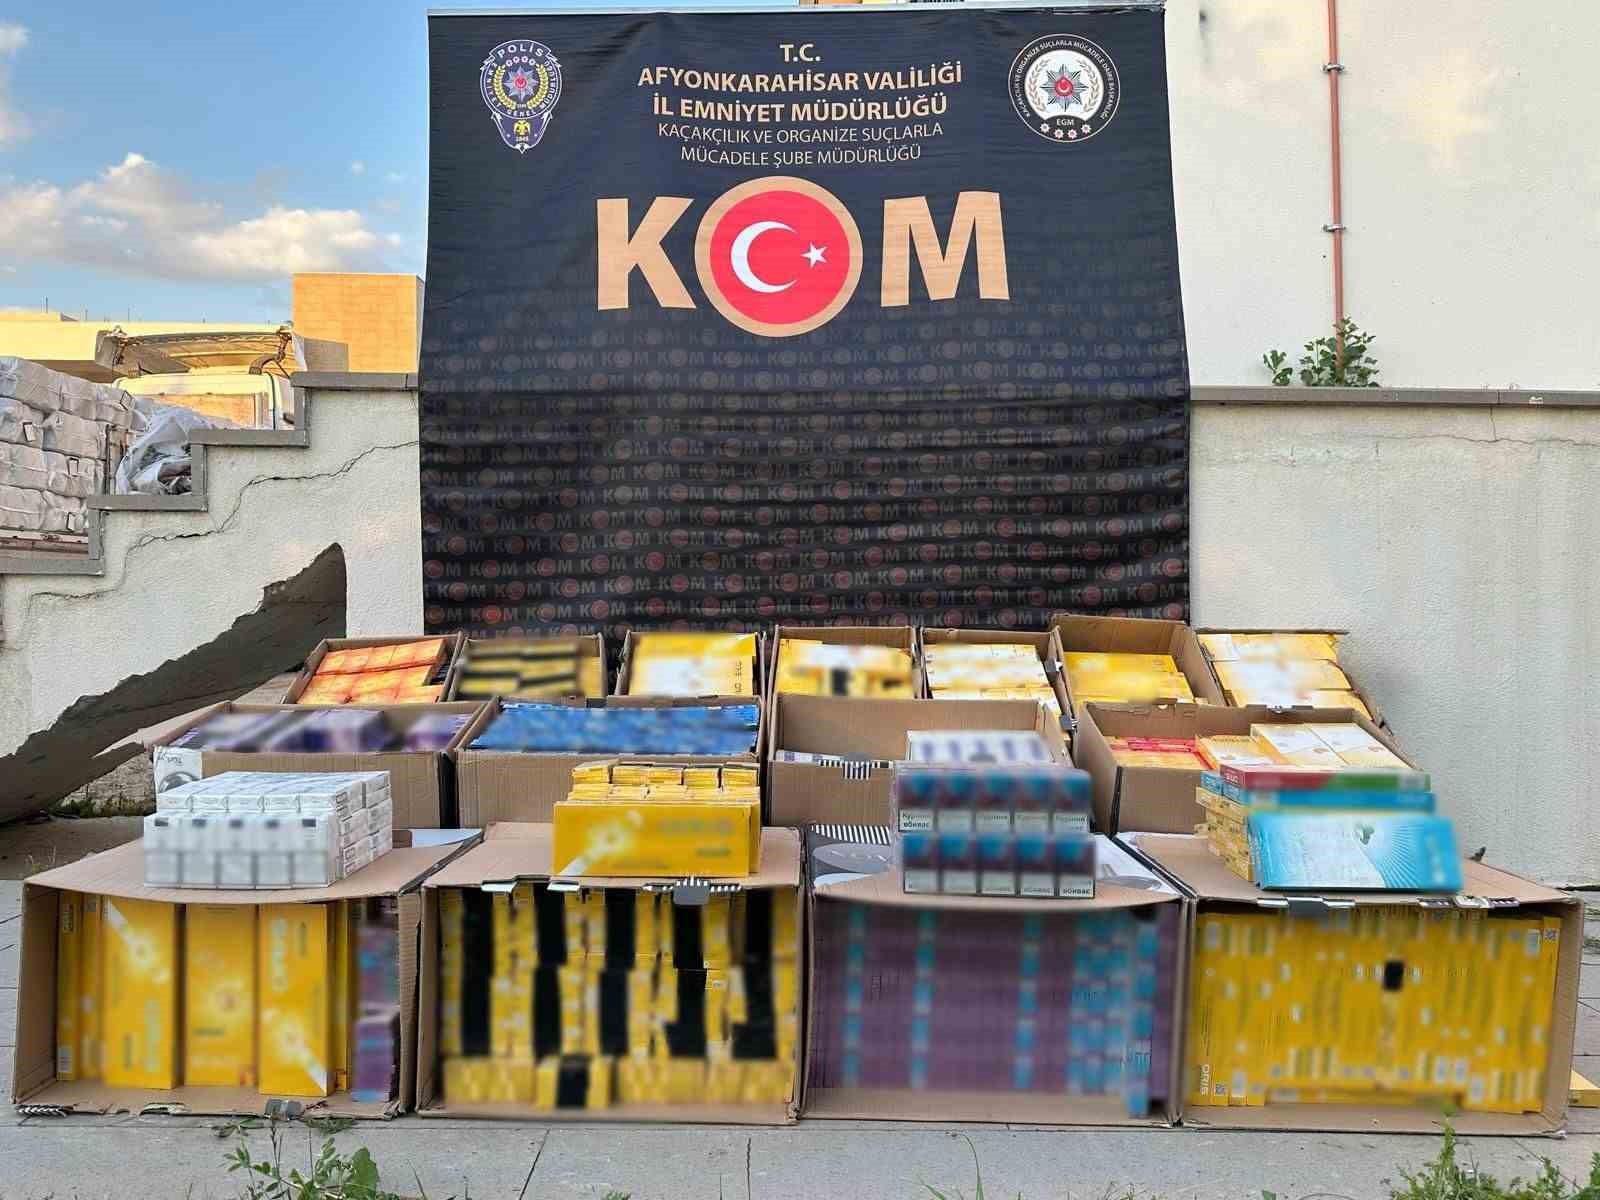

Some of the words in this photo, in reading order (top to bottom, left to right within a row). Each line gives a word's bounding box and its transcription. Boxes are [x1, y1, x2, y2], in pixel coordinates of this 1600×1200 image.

[497, 43, 544, 58] POLİS
[780, 44, 821, 62] T.C.
[637, 66, 859, 93] AFYONKARAHİSAR
[864, 60, 962, 91] VALİLİĞİ
[652, 92, 674, 117] İL
[680, 98, 785, 123] EMNİYET
[791, 92, 947, 122] MÜDÜRLÜĞÜ
[658, 123, 750, 146] KAÇAKÇILIK
[753, 129, 773, 144] VE
[776, 125, 857, 144] ORGANİZE
[862, 122, 943, 144] SUÇLARLA
[680, 145, 769, 166] MÜCADELE
[773, 149, 813, 168] ŞUBE
[817, 143, 921, 165] MÜDÜRLÜĞÜ
